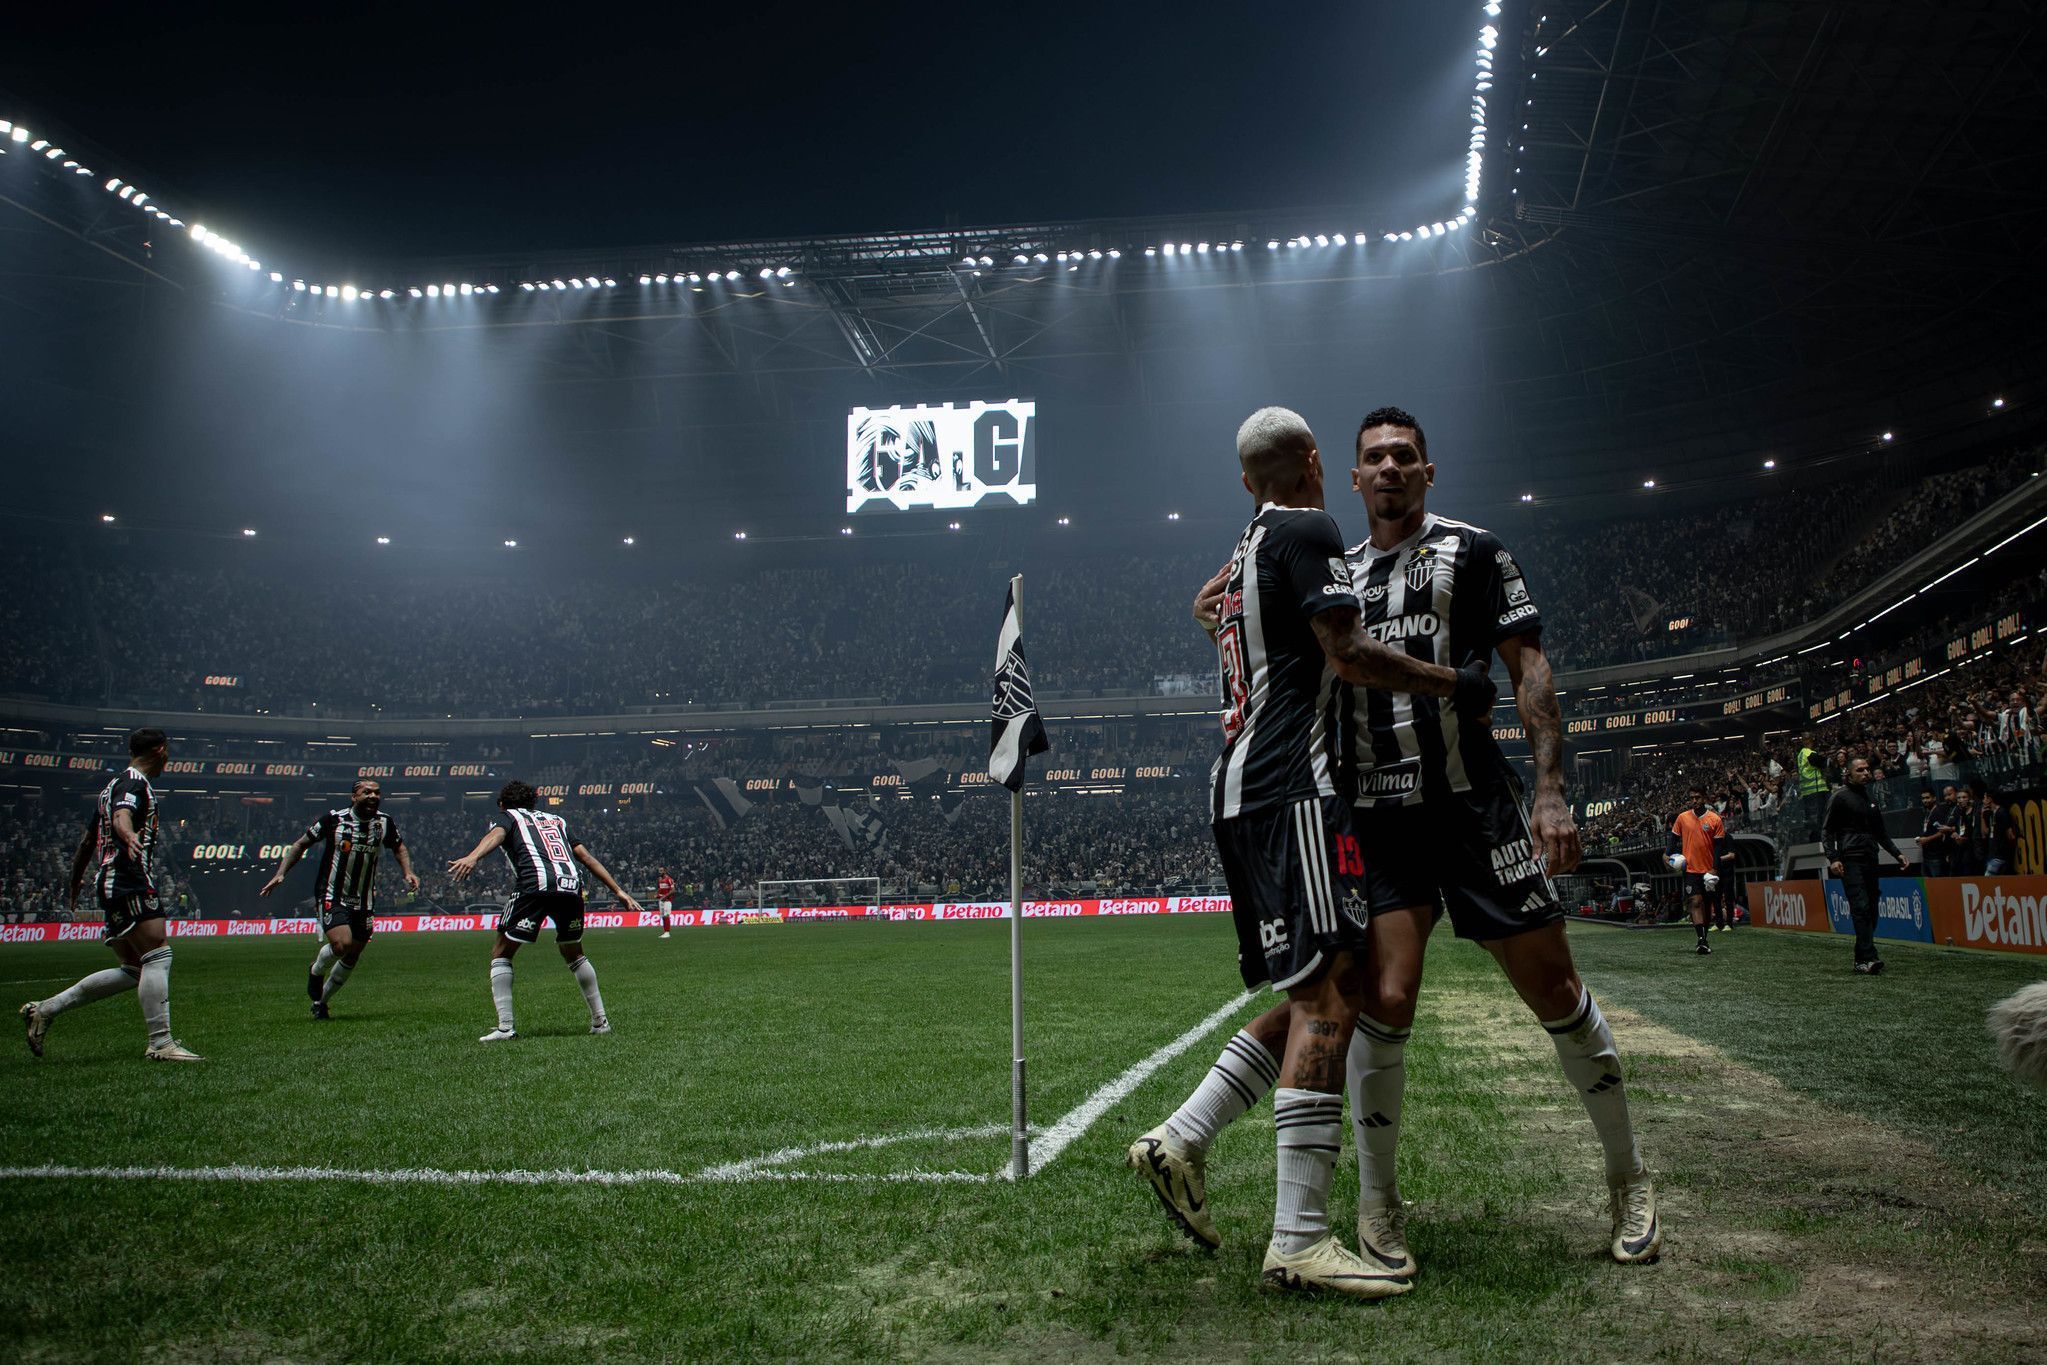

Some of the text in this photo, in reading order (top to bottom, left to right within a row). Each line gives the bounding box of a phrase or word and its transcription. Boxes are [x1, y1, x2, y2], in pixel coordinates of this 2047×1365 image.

[1367, 614, 1437, 642] ETANO
[205, 675, 237, 686] GOOL!
[1567, 709, 1676, 733] GOOL! GOOL! GOOL!
[1492, 728, 1526, 740] GOOL!
[25, 753, 61, 767] GOOL!
[68, 756, 103, 770] GOOL!
[164, 762, 305, 776] GOOL! GOOL! GOOL!
[358, 765, 486, 777] GOOL! GOOL! GOOL!
[1046, 766, 1171, 781] GOOL! GOOL! GOOL!
[536, 783, 655, 797] GOOL! GOOL! GOOL!
[746, 779, 780, 790] GOOL!
[1362, 772, 1414, 792] Vilma
[1586, 801, 1616, 817] GOO
[193, 845, 245, 859] GOOL!
[540, 828, 570, 862] 6
[1334, 832, 1365, 878] 13
[560, 877, 577, 890] BH
[943, 904, 1003, 918] Betano
[1021, 902, 1082, 917] Betano
[1098, 899, 1160, 915] Betano
[1764, 886, 1806, 926] Betano
[1840, 895, 1851, 920] Cop
[1887, 895, 1912, 920] BRASIL
[177, 916, 474, 936] Betano Betano Betan ano Betano
[584, 913, 623, 928] tano
[638, 911, 694, 926] Beno
[0, 925, 45, 942] etano
[1259, 918, 1288, 950] bc
